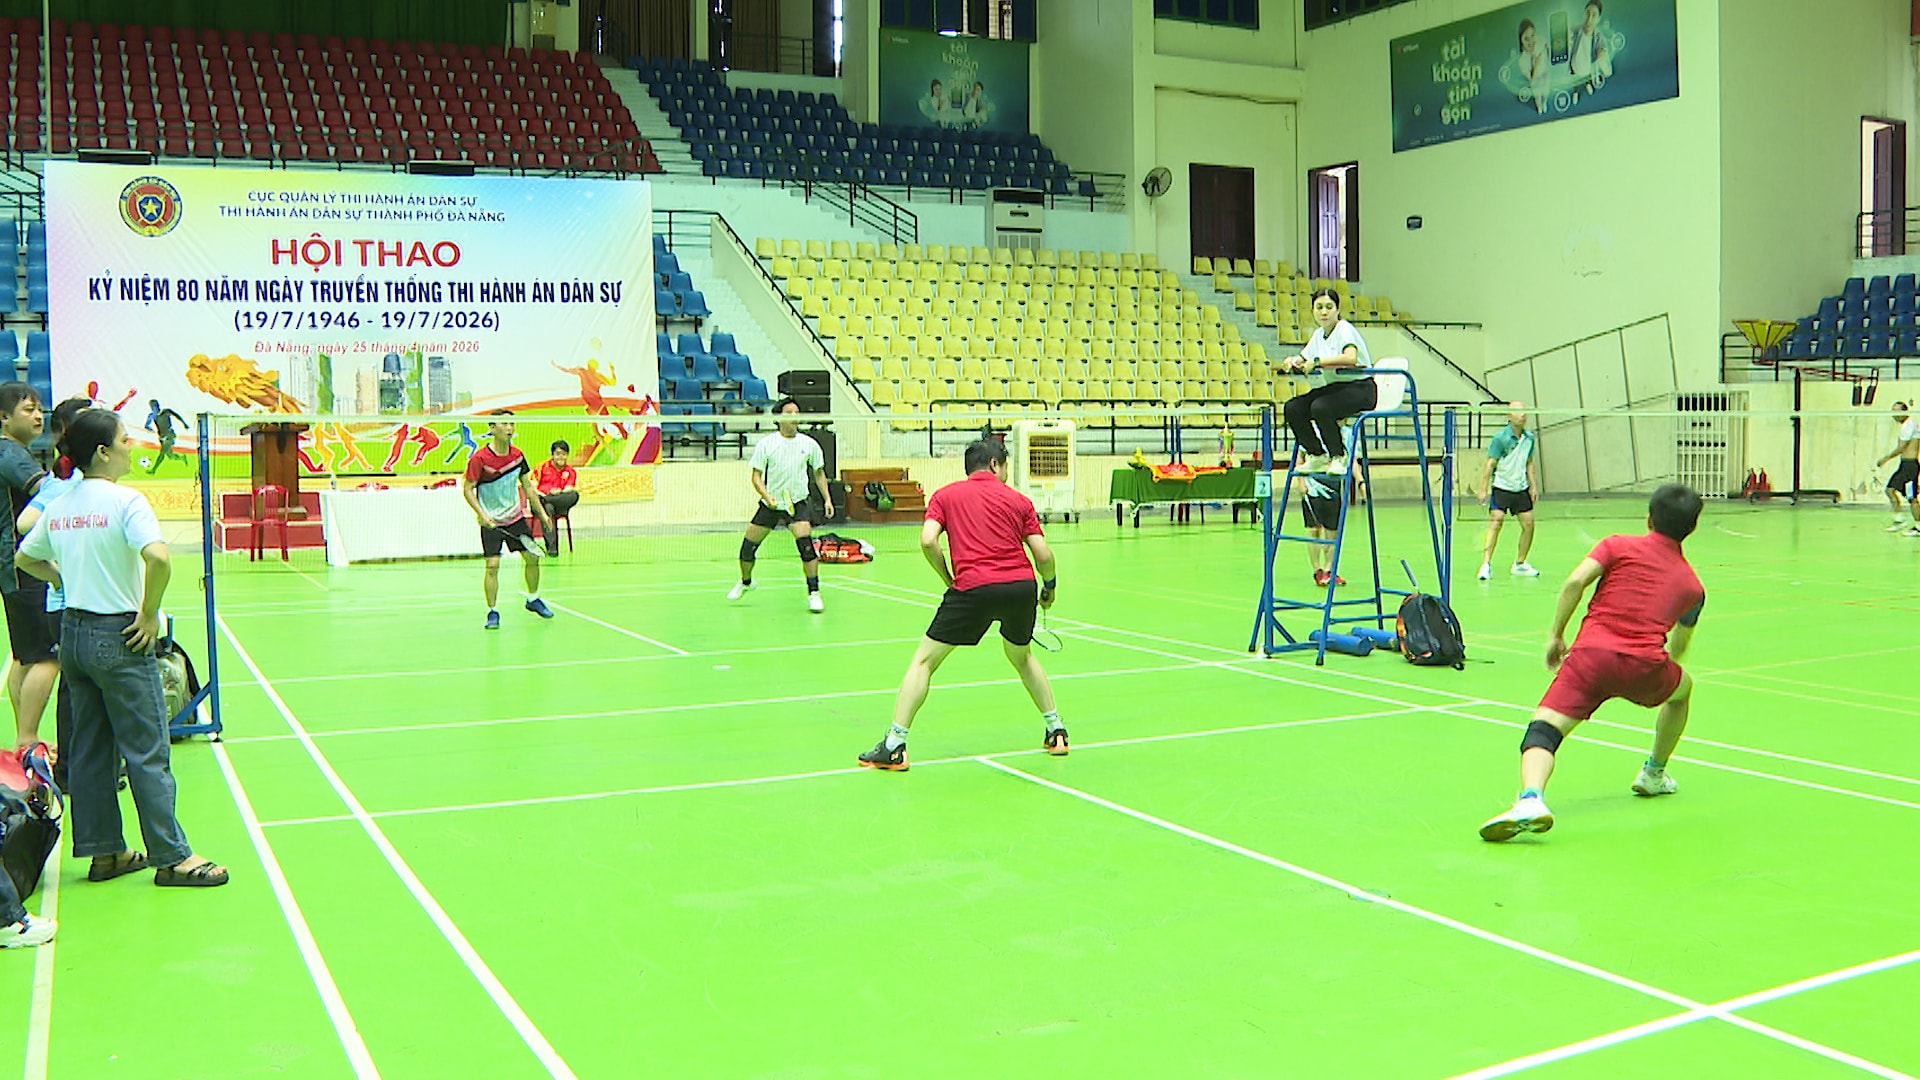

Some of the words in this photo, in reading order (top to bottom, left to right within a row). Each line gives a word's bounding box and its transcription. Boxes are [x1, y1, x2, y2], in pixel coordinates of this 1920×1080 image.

[1448, 81, 1479, 104] tinh
[1441, 106, 1471, 125] gọn
[247, 191, 276, 204] CỤC
[280, 190, 319, 204] QUẢN
[323, 191, 337, 204] LÝ
[341, 194, 361, 204] THI
[365, 192, 404, 205] HÀNH
[407, 192, 425, 206] ÁN
[429, 194, 457, 206] DÂN
[460, 196, 478, 208] SỰ
[219, 205, 242, 217] THI
[246, 203, 286, 217] HÀNH
[289, 206, 308, 218] ÁN
[312, 206, 341, 219] DÂN
[345, 209, 363, 221] SỰ
[367, 207, 413, 220] THÀNH
[416, 207, 444, 222] PHỐ
[447, 211, 466, 222] ĐÀ
[468, 208, 506, 222] NẴNG
[271, 232, 342, 273] HỘI
[352, 240, 461, 267] THAO
[89, 269, 113, 301] KỶ
[120, 273, 170, 306] NIỆM
[177, 279, 199, 301] 80
[205, 275, 249, 302] NĂM
[256, 275, 304, 303] NGÀY
[310, 273, 379, 303] TRUYỀN
[384, 273, 442, 303] THỐNG
[448, 281, 475, 303] THI
[480, 278, 526, 303] HÀNH
[532, 277, 555, 303] ÁN
[560, 277, 595, 303] DÂN
[600, 280, 623, 307] SỰ
[234, 309, 361, 332] (19/7/1946
[381, 310, 500, 332] 19/7/2026)
[254, 341, 271, 353] Đà
[317, 341, 348, 355] ngày
[353, 342, 367, 353] 25
[370, 341, 406, 355] tháng
[410, 341, 417, 353] 4
[420, 341, 448, 353] năm
[451, 341, 480, 353] 2026
[1259, 480, 1267, 495] 2
